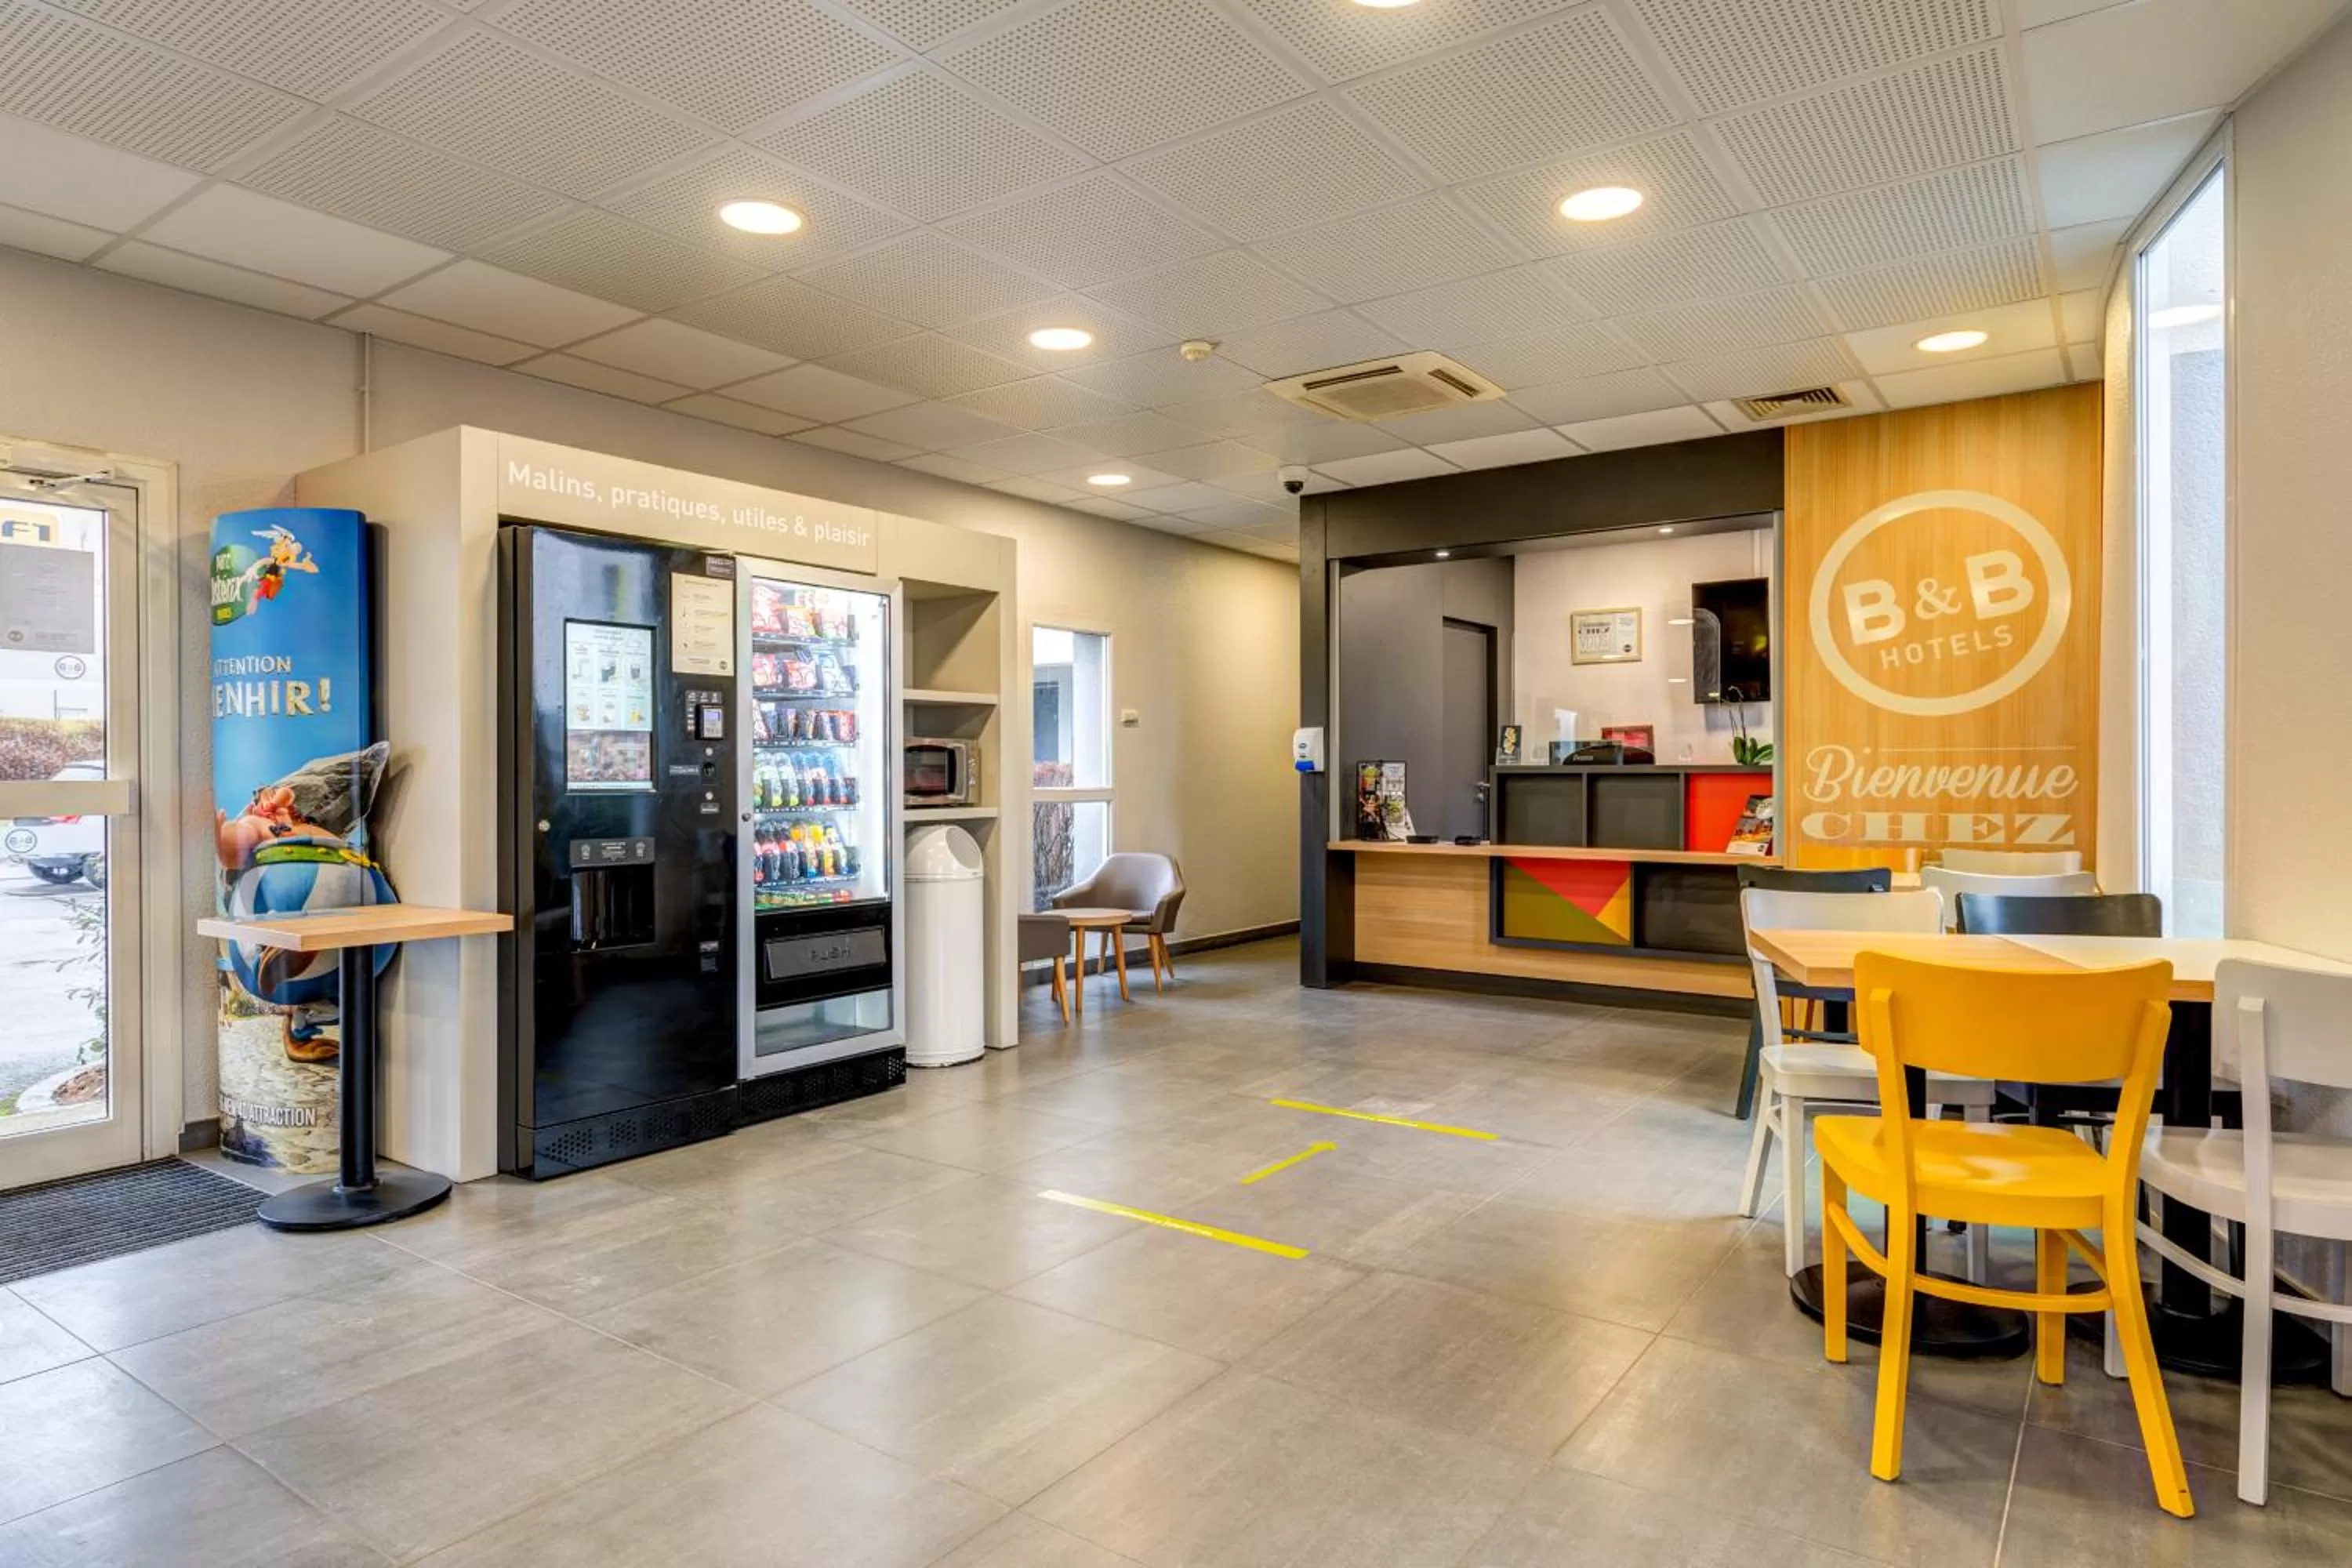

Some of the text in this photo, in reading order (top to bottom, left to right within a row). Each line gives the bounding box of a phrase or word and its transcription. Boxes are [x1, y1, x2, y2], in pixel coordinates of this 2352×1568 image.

[508, 460, 870, 546] Malins, pratiques, utiles & plaisir
[1843, 550, 2034, 646] B&B
[1880, 625, 2014, 670] HOTELS
[213, 677, 332, 719] ENHIR!
[1803, 744, 2079, 803] Bienvenue
[1801, 811, 2075, 845] CHEZ
[249, 1103, 316, 1127] ATTRACTION
